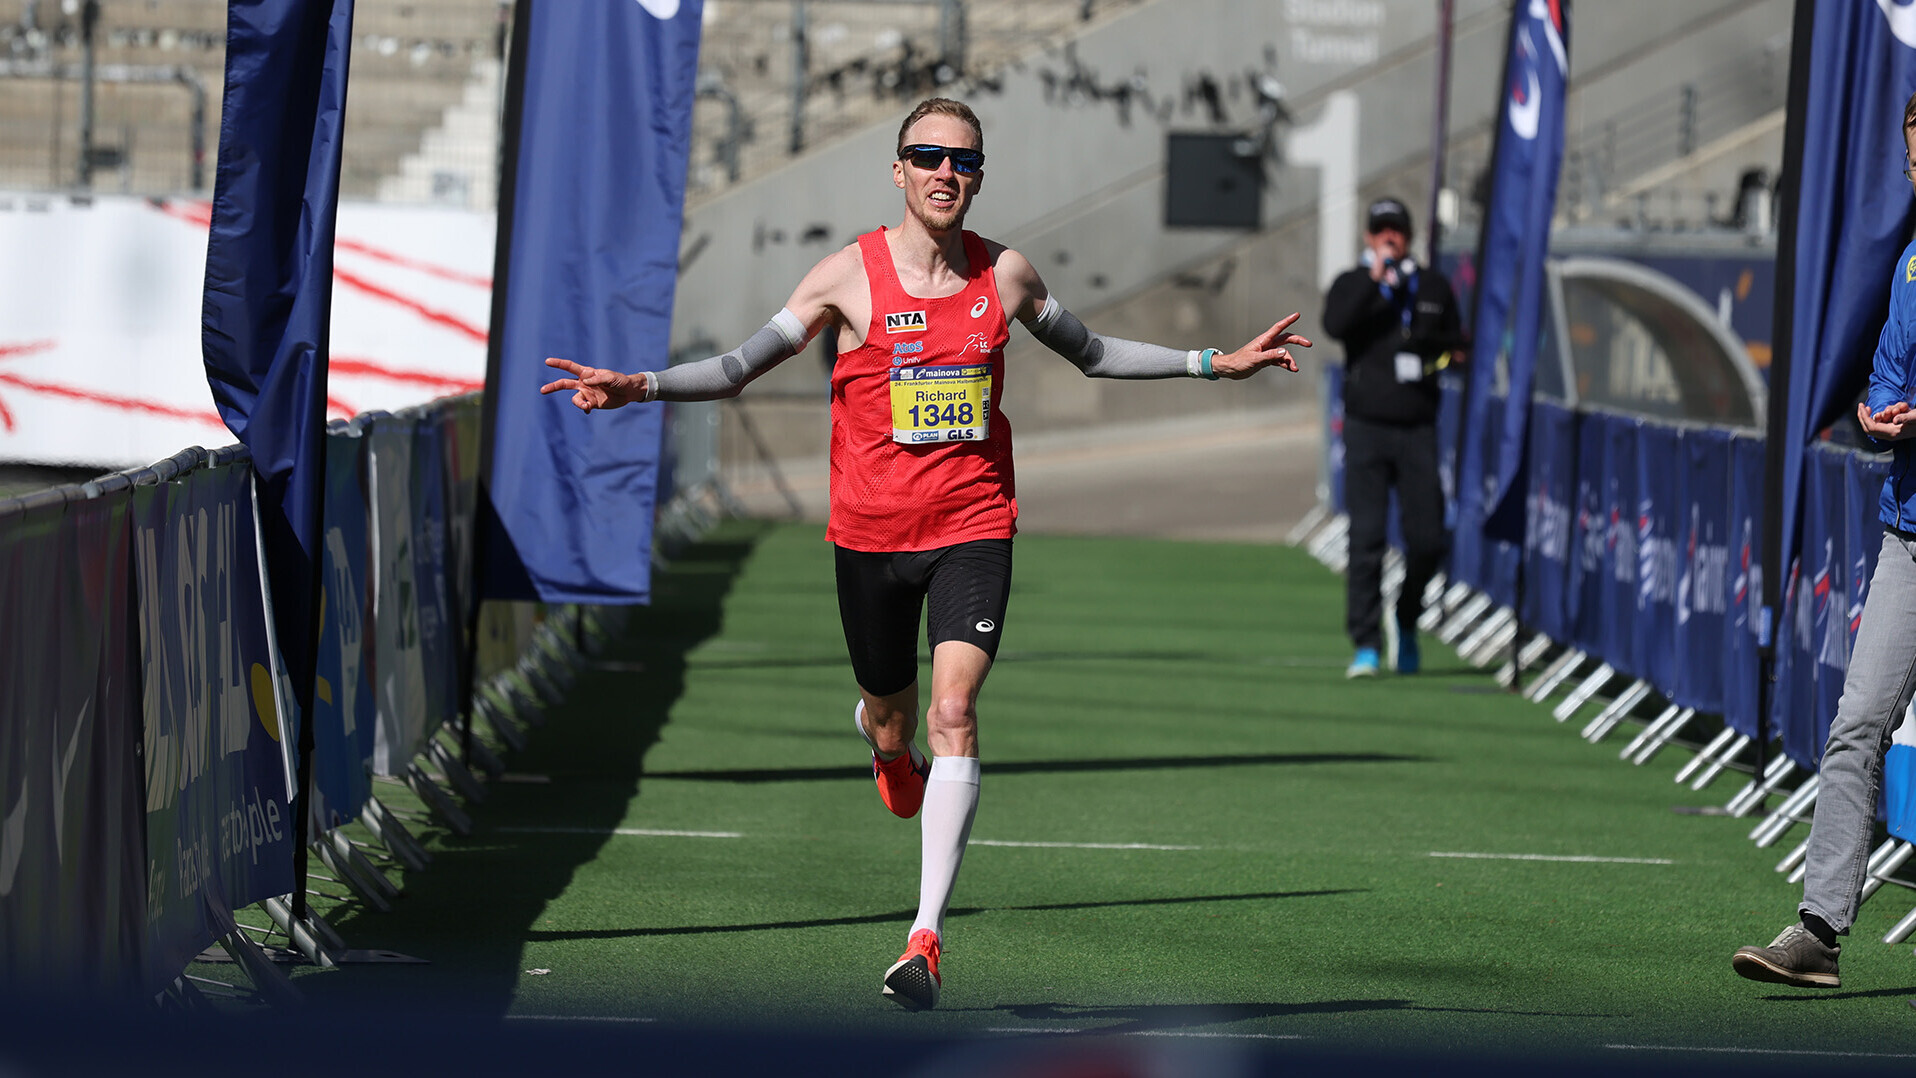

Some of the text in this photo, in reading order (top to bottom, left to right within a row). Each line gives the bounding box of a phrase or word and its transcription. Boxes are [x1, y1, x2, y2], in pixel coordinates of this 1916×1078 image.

[1286, 90, 1358, 290] 1
[887, 312, 924, 327] NTA
[925, 369, 960, 377] mainova
[916, 389, 966, 402] Richard
[908, 402, 974, 427] 1348
